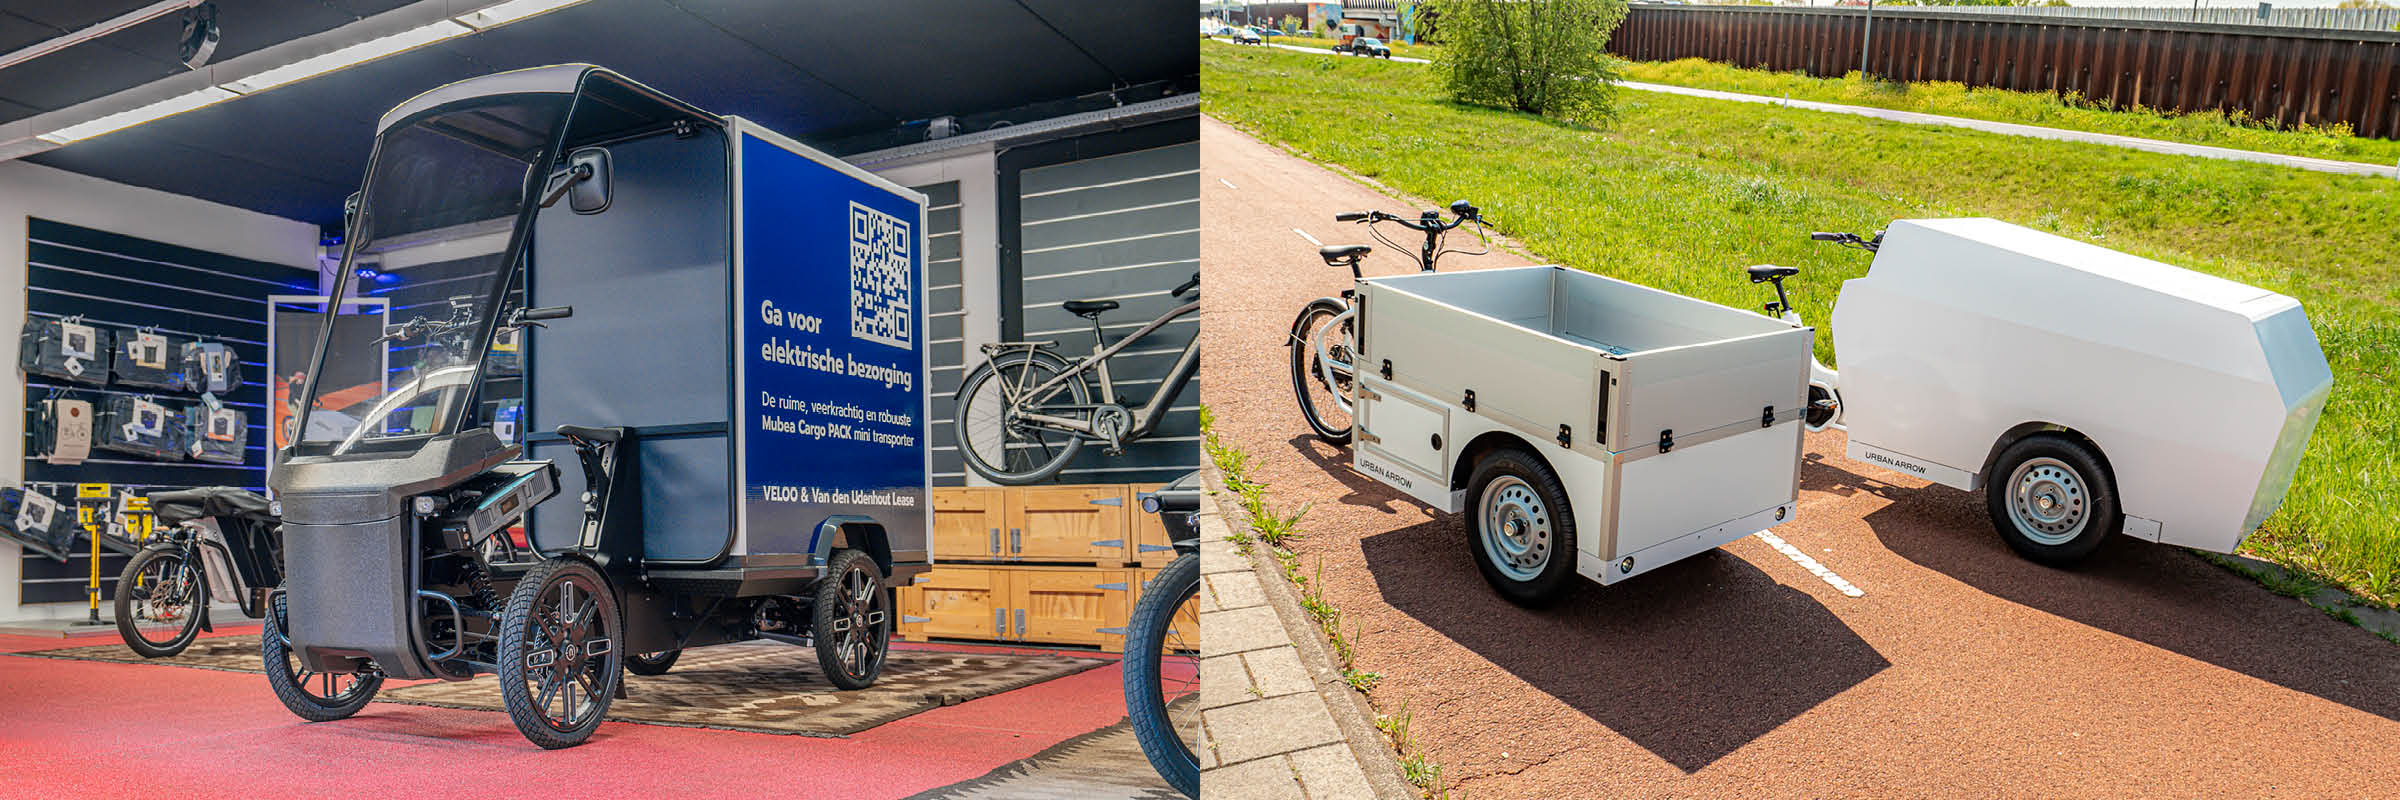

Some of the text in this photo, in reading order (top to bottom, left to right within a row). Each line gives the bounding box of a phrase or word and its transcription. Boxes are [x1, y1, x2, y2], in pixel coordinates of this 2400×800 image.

[761, 299, 822, 334] Ga voor
[761, 336, 912, 392] elektrische bezorging
[762, 391, 912, 427] De ruime, veerkrachtig en robuuste
[762, 415, 914, 448] Mubea Cargo PACK mini transporter
[1360, 458, 1412, 488] URBAN ARROW
[1865, 451, 1926, 474] URBAN ARROW
[763, 485, 915, 506] VELOO & Van den Udenhout Lease
